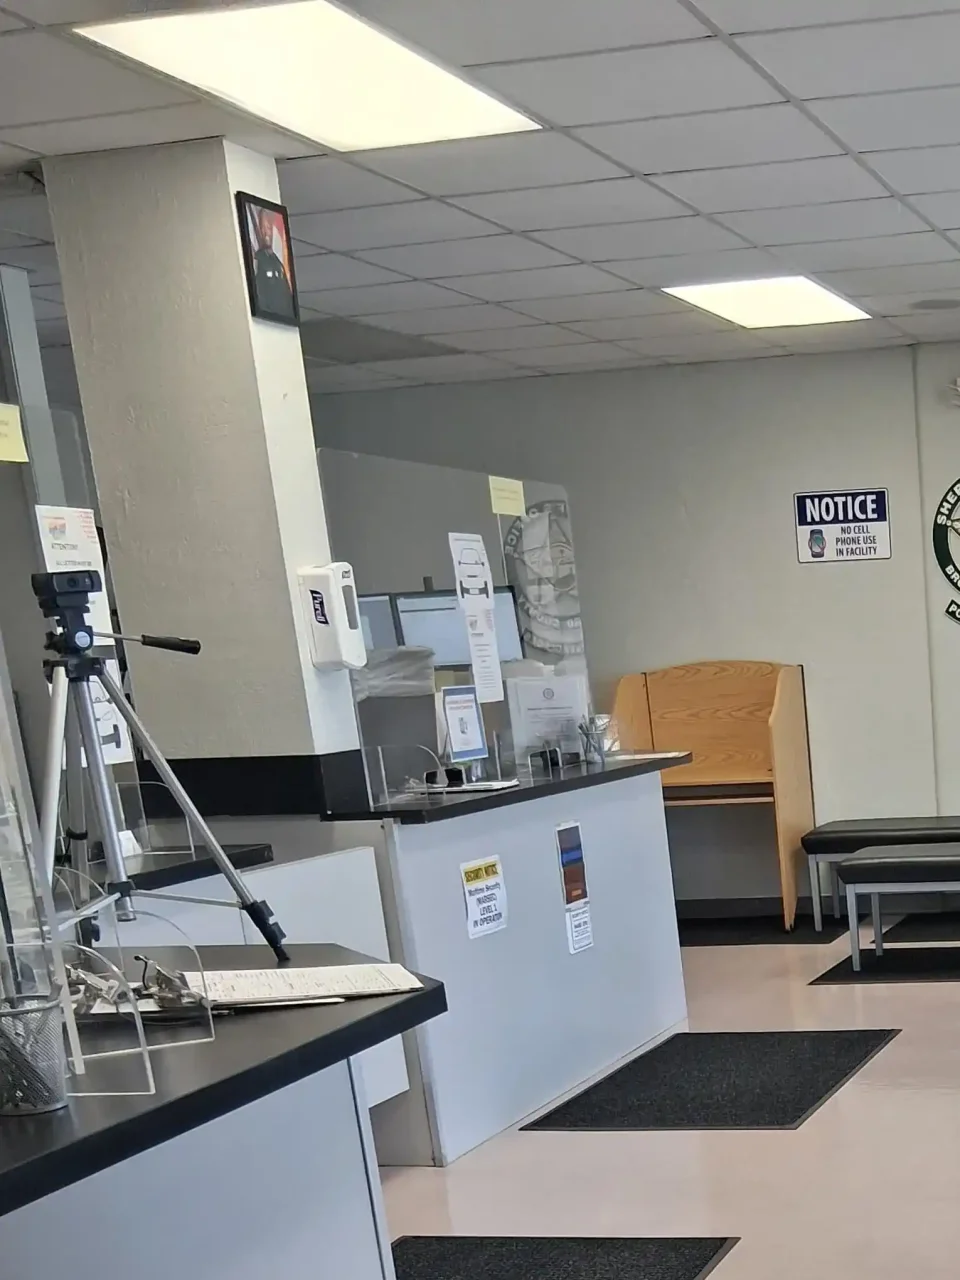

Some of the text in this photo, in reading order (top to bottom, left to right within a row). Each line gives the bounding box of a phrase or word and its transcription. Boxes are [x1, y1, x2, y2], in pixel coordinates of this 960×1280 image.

[805, 494, 878, 523] NOTICE
[840, 524, 870, 535] NO CELL
[835, 535, 877, 546] PHONE USE
[836, 546, 878, 557] IN FACILITY
[480, 905, 493, 916] LEVEL
